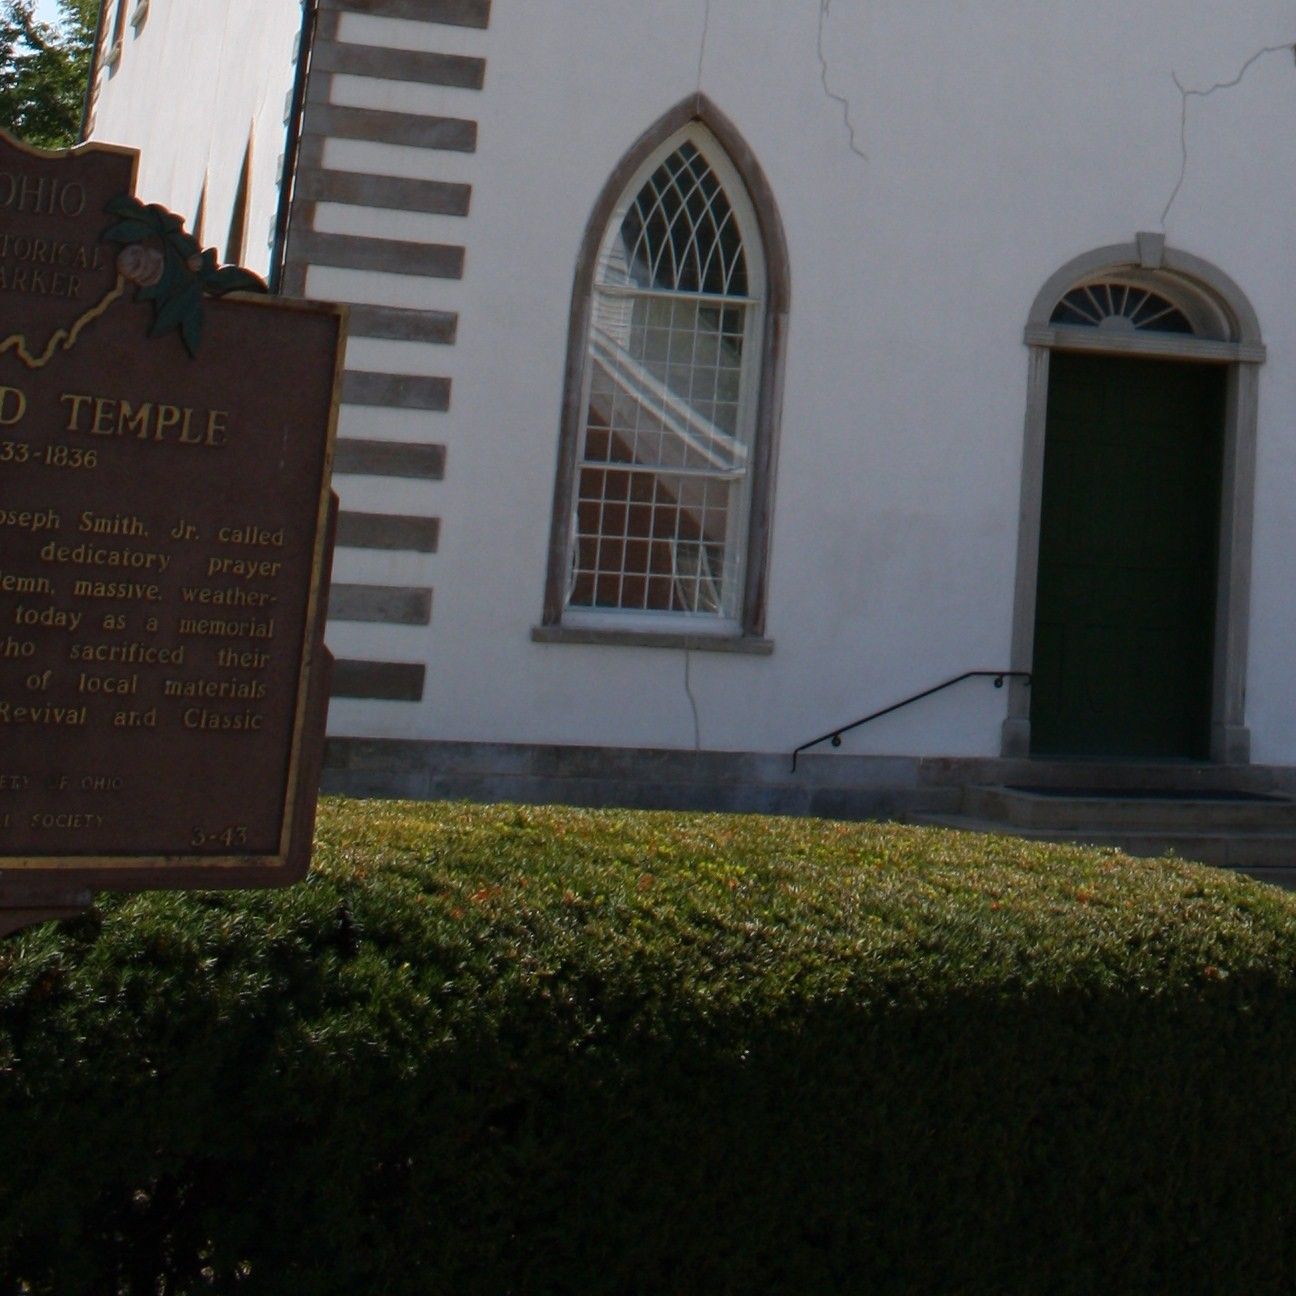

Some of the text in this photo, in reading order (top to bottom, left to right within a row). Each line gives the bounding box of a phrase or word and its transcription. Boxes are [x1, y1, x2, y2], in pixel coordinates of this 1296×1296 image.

[0, 172, 86, 217] OHIO
[60, 393, 229, 447] TEMPLE
[170, 520, 199, 540] Jr.
[217, 527, 284, 546] called
[40, 541, 281, 578] dedicatory prayer
[181, 587, 277, 607] weather-
[15, 605, 274, 638] today as a memorial
[70, 641, 184, 664] sacrificed
[217, 648, 270, 668] their
[26, 669, 266, 698] of local materials
[183, 708, 263, 729] Classic
[31, 813, 103, 828] SOCIETY
[190, 827, 248, 847] 3-43
